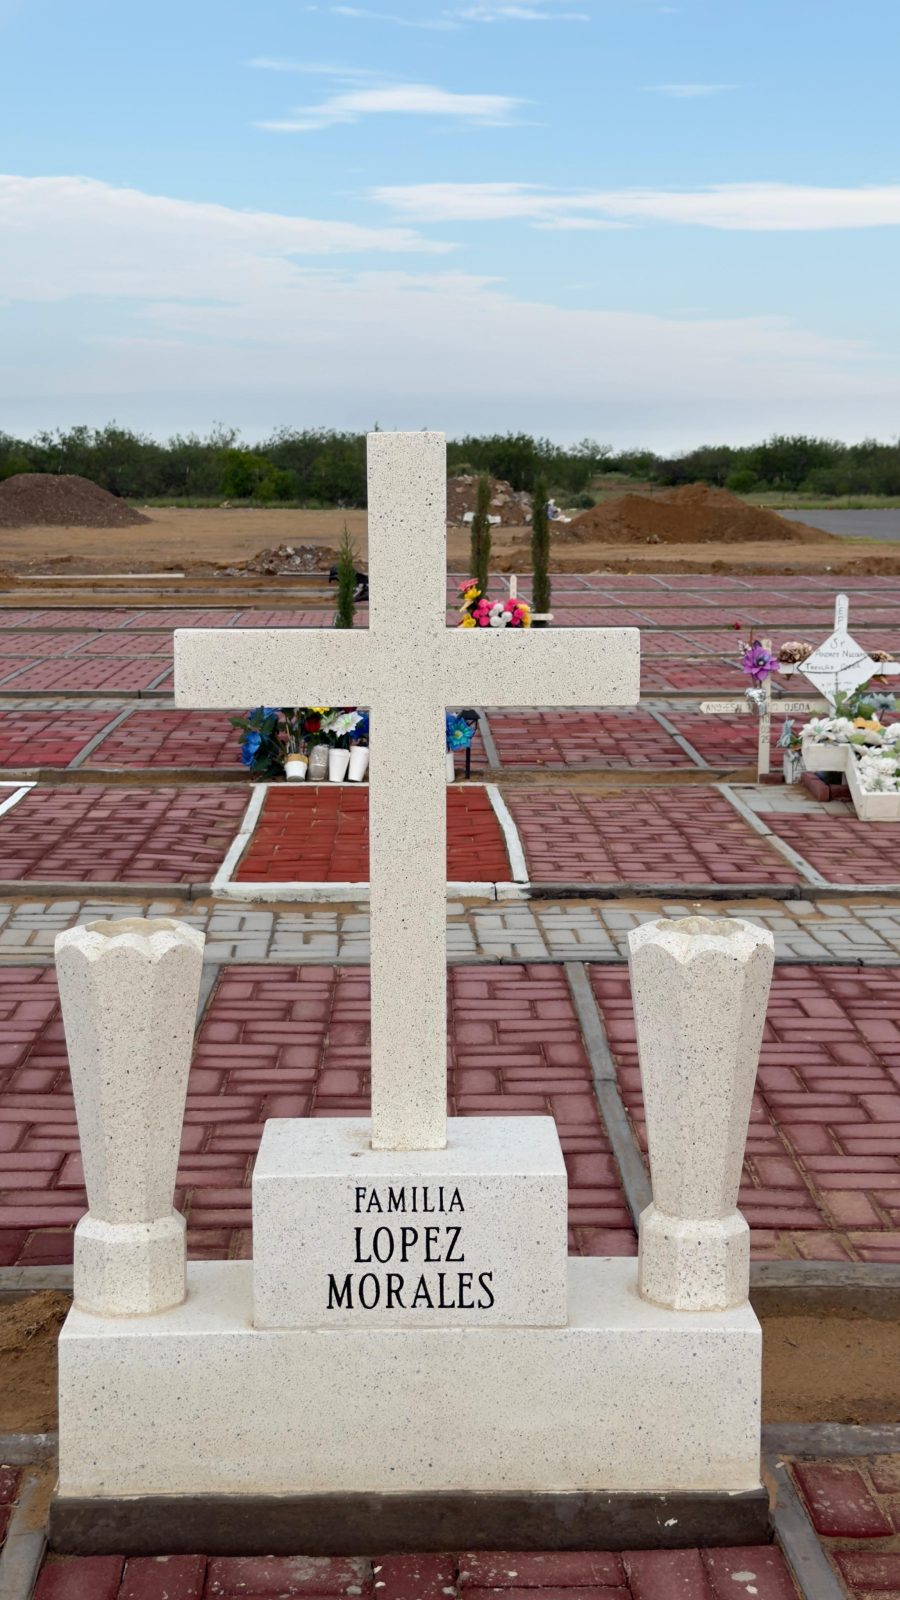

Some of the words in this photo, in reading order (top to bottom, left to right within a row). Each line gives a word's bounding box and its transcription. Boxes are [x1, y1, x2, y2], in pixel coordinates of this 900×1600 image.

[784, 703, 810, 711] OJEDA
[354, 1186, 465, 1213] FAMILIA
[354, 1226, 465, 1263] LOPEZ
[326, 1271, 495, 1310] MORALES
